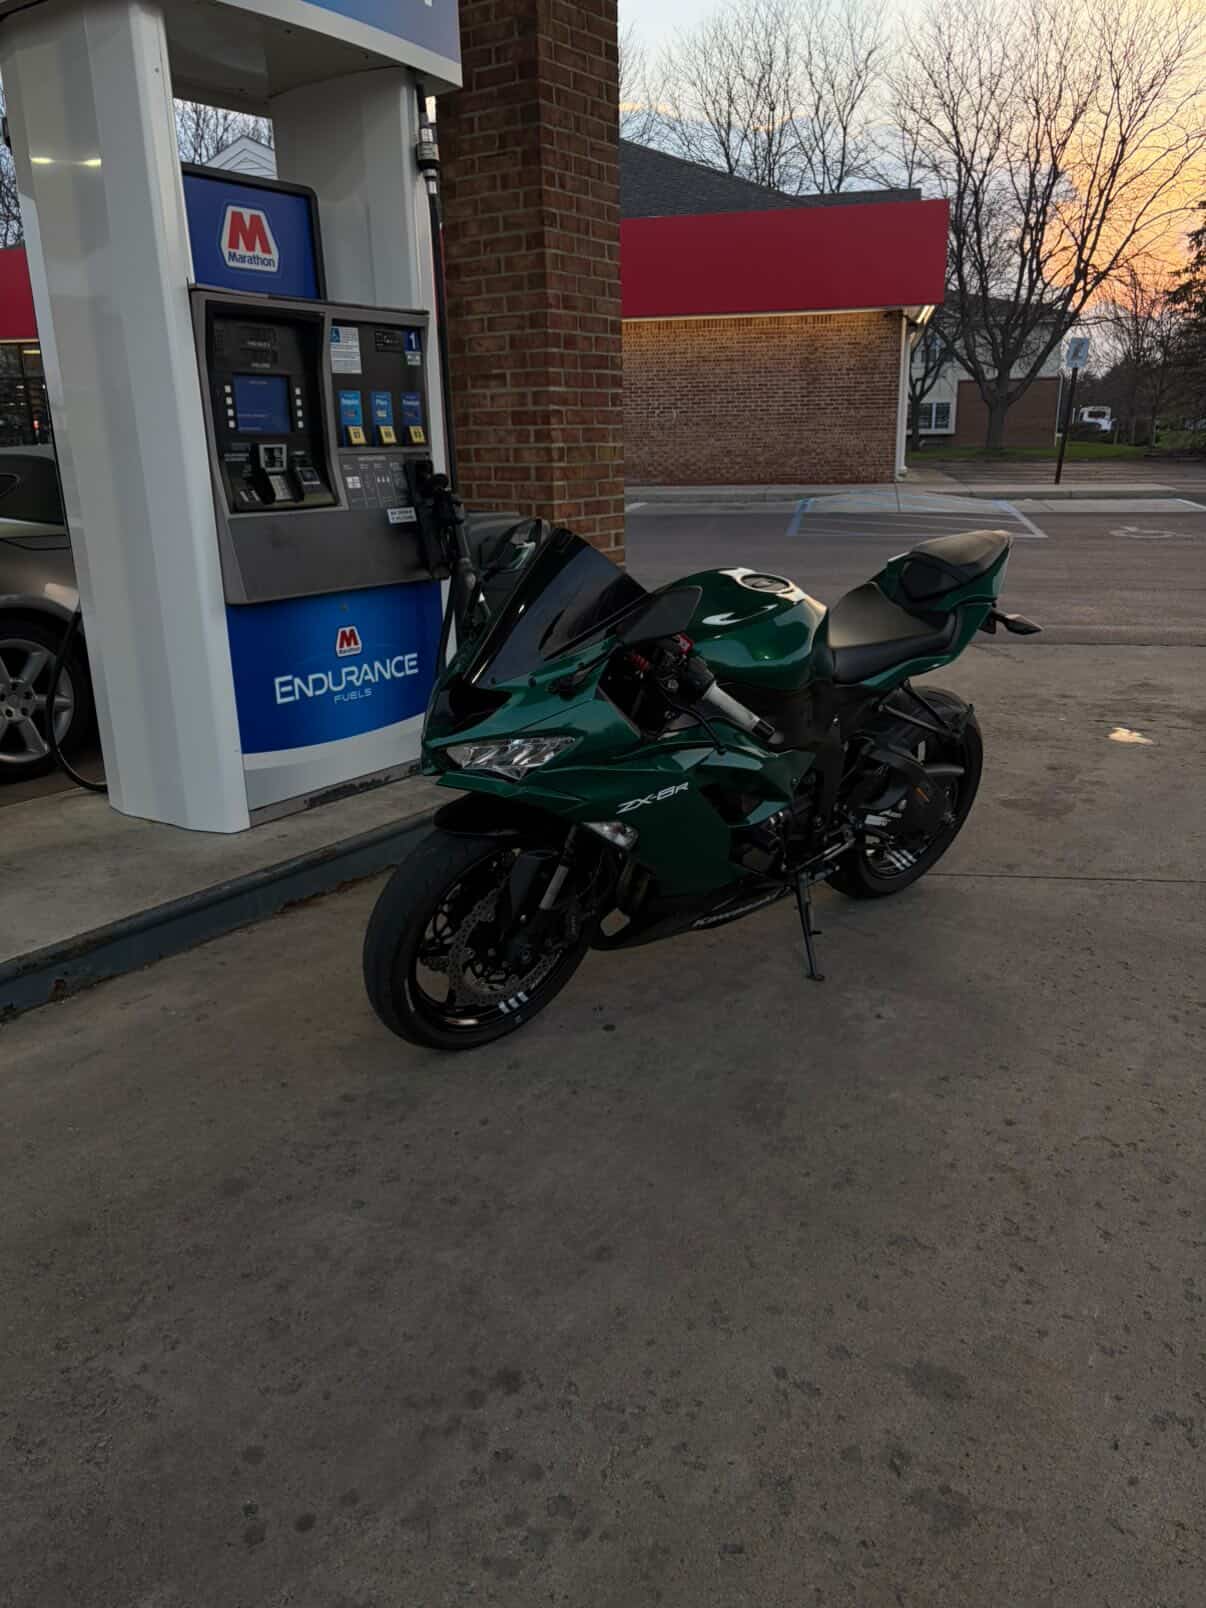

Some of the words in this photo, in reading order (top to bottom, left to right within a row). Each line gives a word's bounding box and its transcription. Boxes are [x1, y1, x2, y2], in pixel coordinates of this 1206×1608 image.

[228, 211, 272, 254] M
[228, 251, 275, 268] Marathon
[409, 332, 416, 349] 1
[339, 628, 359, 648] M
[274, 652, 419, 705] ENDURANCE
[334, 688, 373, 704] FUELS
[616, 782, 689, 815] ZX-6R
